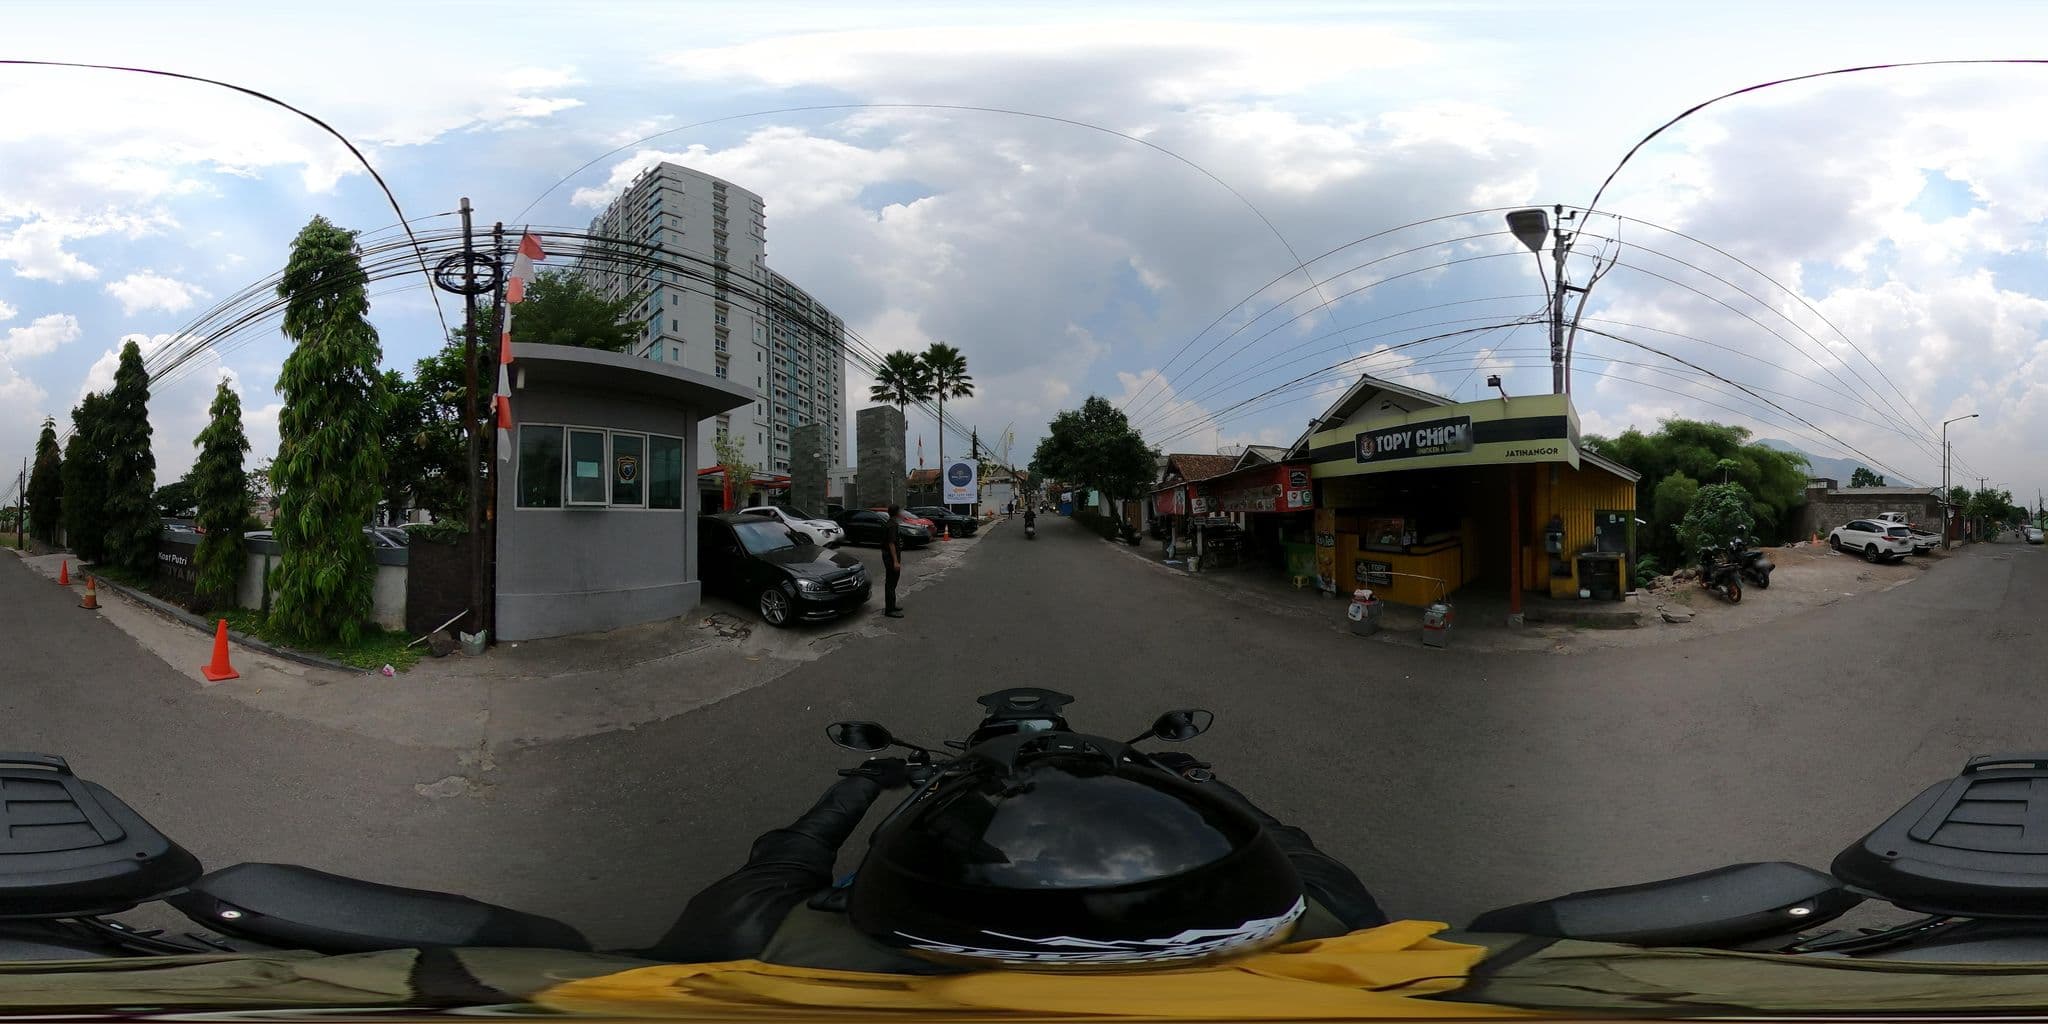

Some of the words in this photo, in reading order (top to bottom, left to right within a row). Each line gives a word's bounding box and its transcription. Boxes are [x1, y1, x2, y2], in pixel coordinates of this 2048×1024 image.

[1376, 431, 1412, 452] TOPY
[1416, 424, 1468, 447] CHICK
[159, 551, 172, 562] Kost
[172, 554, 187, 566] Putri
